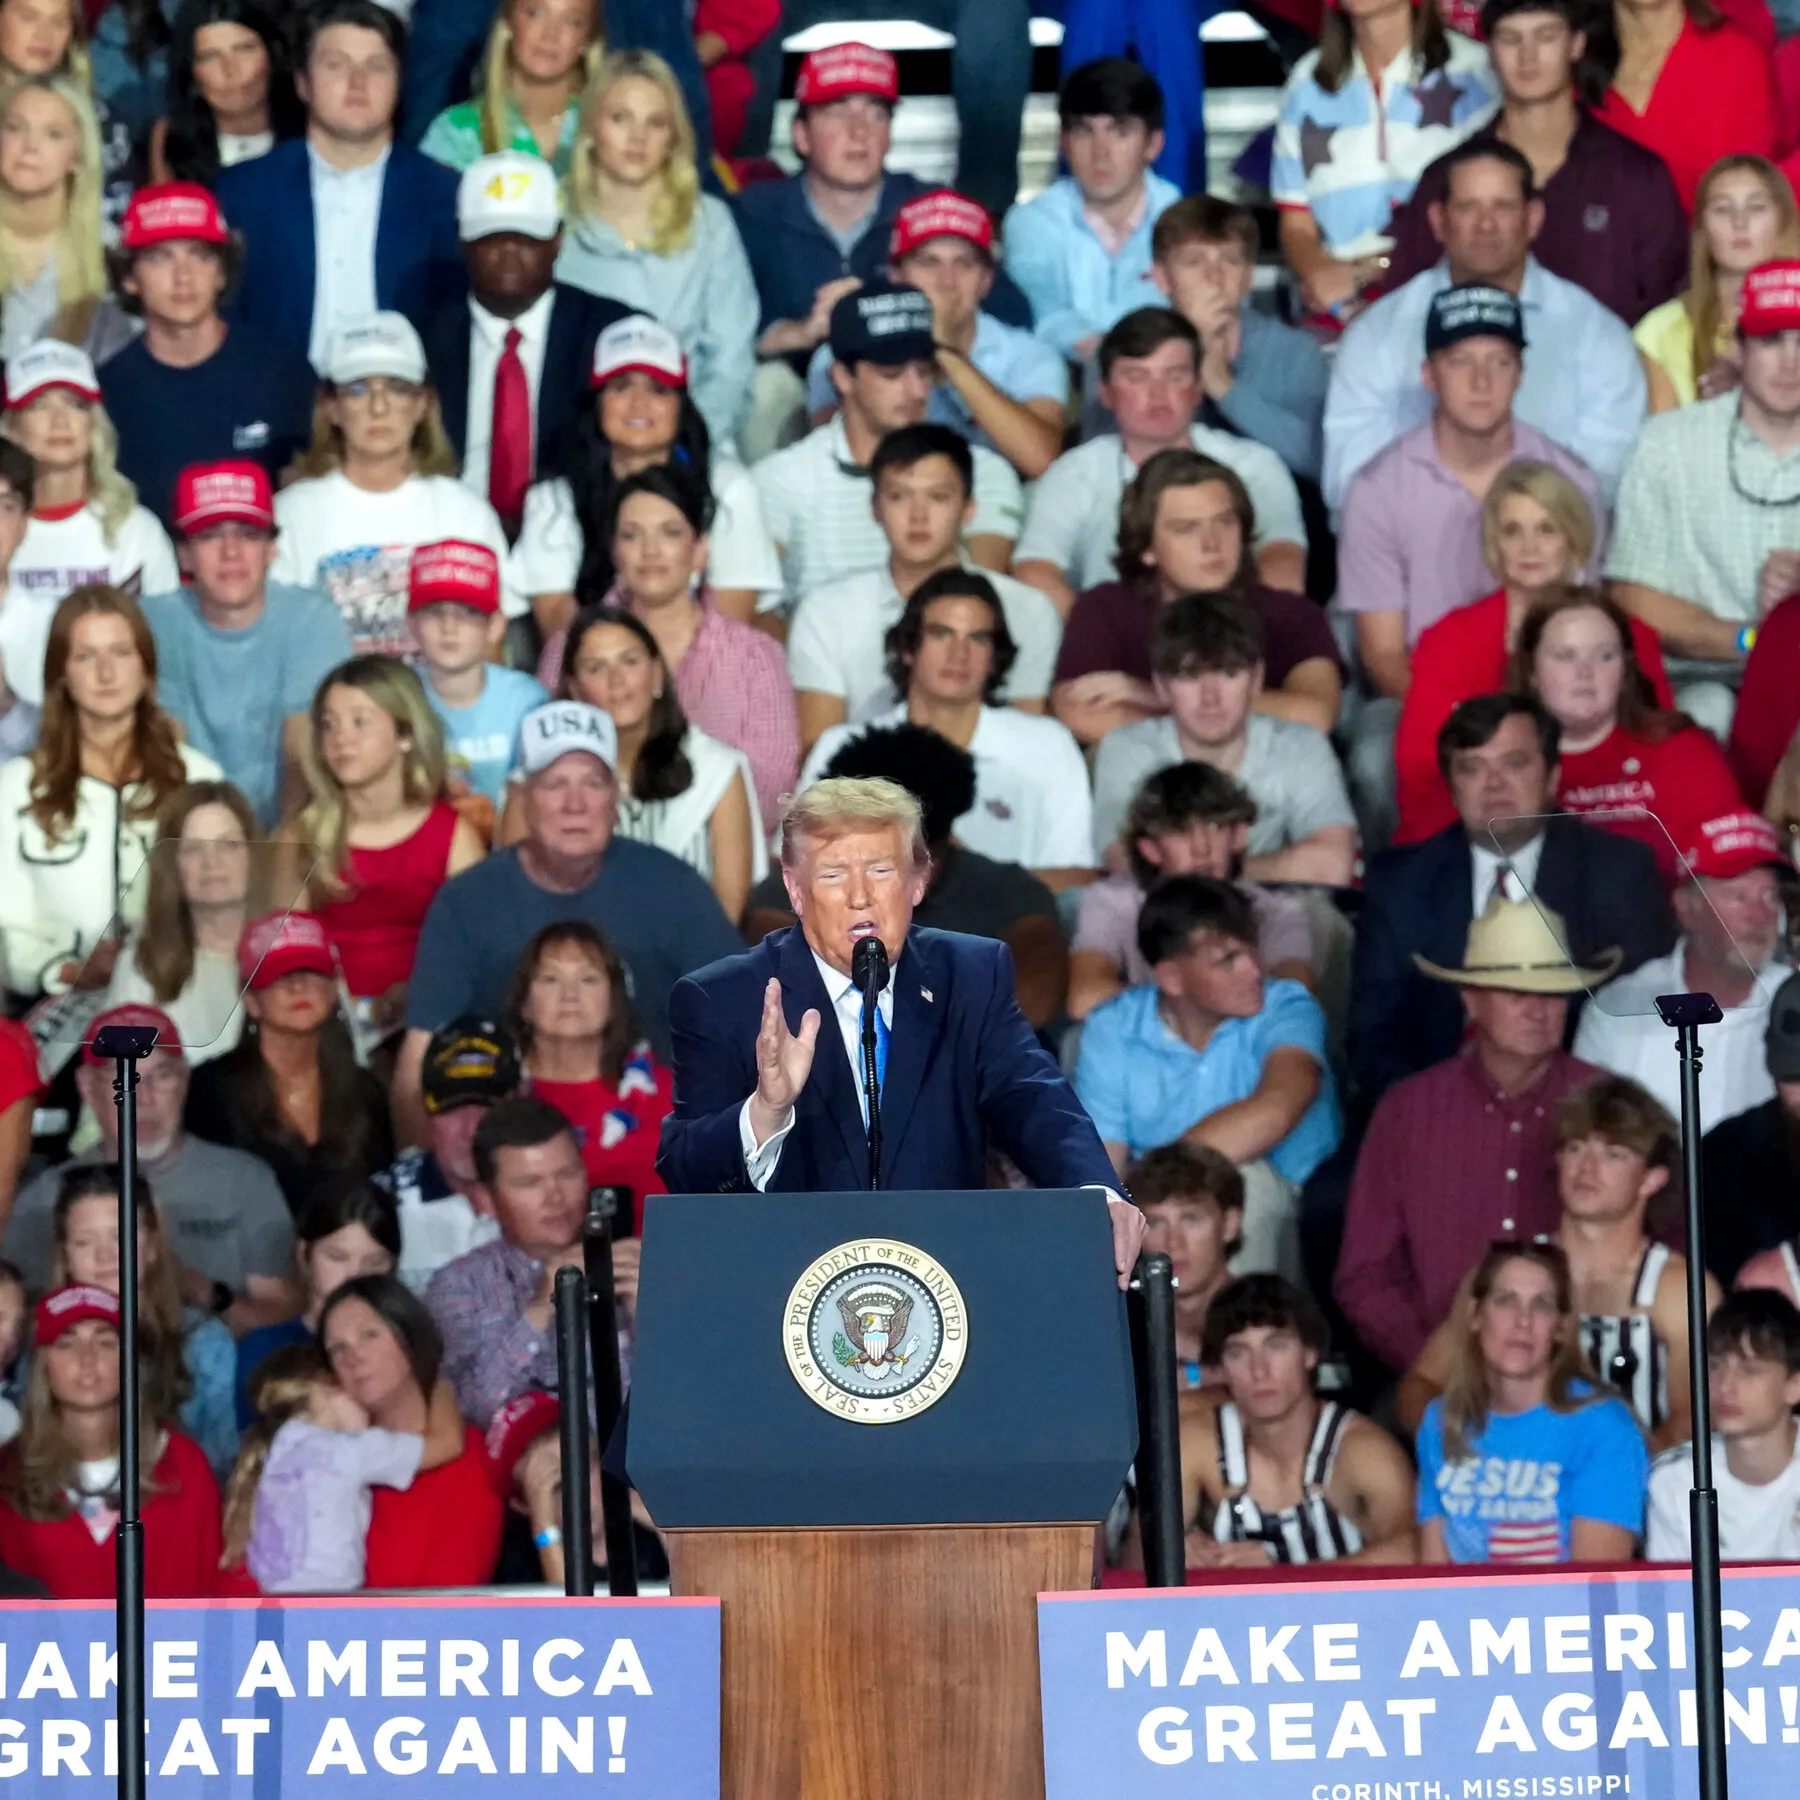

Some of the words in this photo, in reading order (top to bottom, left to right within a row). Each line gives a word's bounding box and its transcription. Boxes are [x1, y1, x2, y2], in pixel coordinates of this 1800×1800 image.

[483, 171, 532, 199] 47
[536, 709, 606, 740] USA
[877, 1247, 893, 1258] OF
[897, 1251, 920, 1269] THE
[790, 1246, 870, 1327] PRESIDENT
[923, 1267, 961, 1341] UNITED
[792, 1334, 804, 1359] THE
[800, 1361, 813, 1377] OF
[893, 1358, 954, 1414] STATES
[813, 1377, 860, 1414] SEAL
[1106, 1622, 1360, 1688] MAKE
[1400, 1608, 1800, 1678] AMERICA
[0, 1641, 197, 1698] AKE
[236, 1639, 653, 1697] AMERICA
[1138, 1698, 1436, 1765] GREAT
[1476, 1686, 1799, 1753] AGAIN!
[307, 1716, 627, 1775] AGAIN!
[1311, 1781, 1450, 1800] CORINTH,
[1463, 1775, 1630, 1799] MISSISSIPPI
